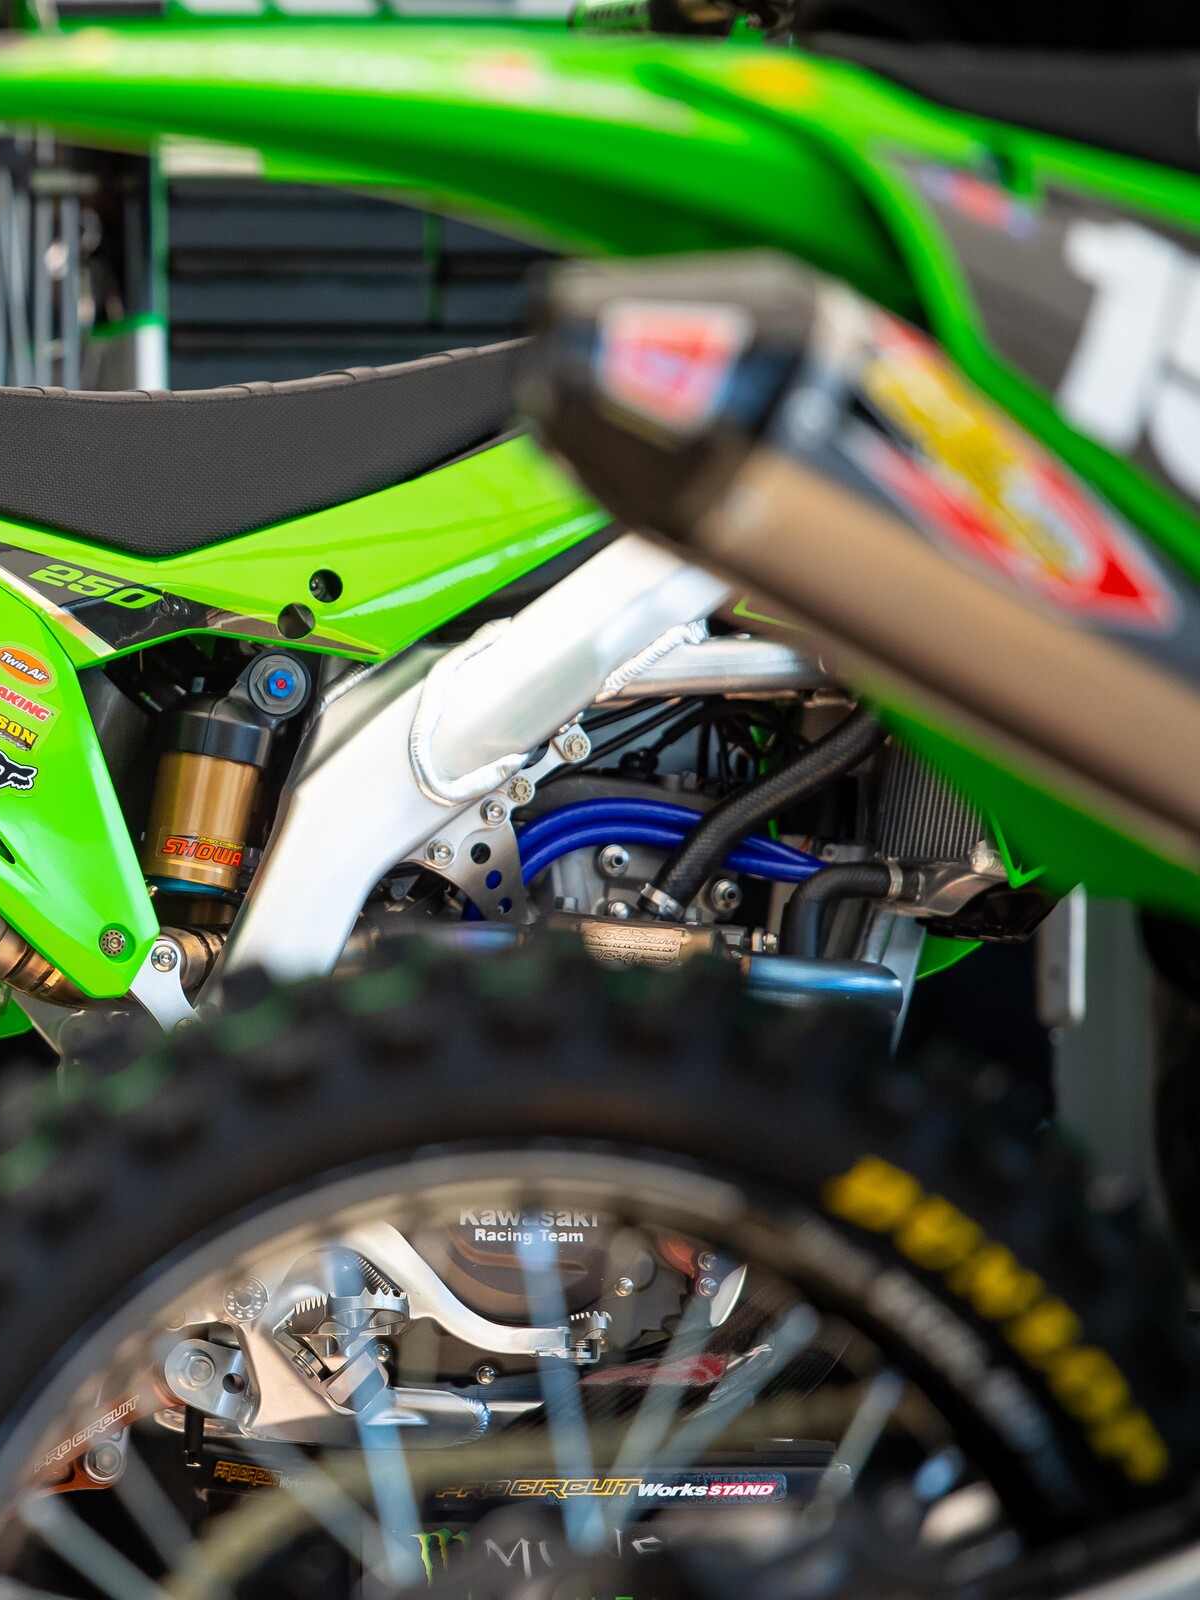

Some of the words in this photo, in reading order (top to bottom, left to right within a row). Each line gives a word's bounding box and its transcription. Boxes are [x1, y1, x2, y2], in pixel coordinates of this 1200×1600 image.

[28, 564, 163, 609] 250
[0, 651, 28, 673] Twin
[27, 667, 48, 682] Air
[161, 837, 243, 868] SHOWA
[474, 1228, 533, 1245] Racing
[538, 1229, 584, 1242] Team
[34, 1439, 71, 1473] PRO
[72, 1394, 139, 1447] CIRCUIT
[509, 1478, 642, 1499] CIRCUIT
[638, 1482, 708, 1497] Works
[708, 1483, 775, 1497] STAND
